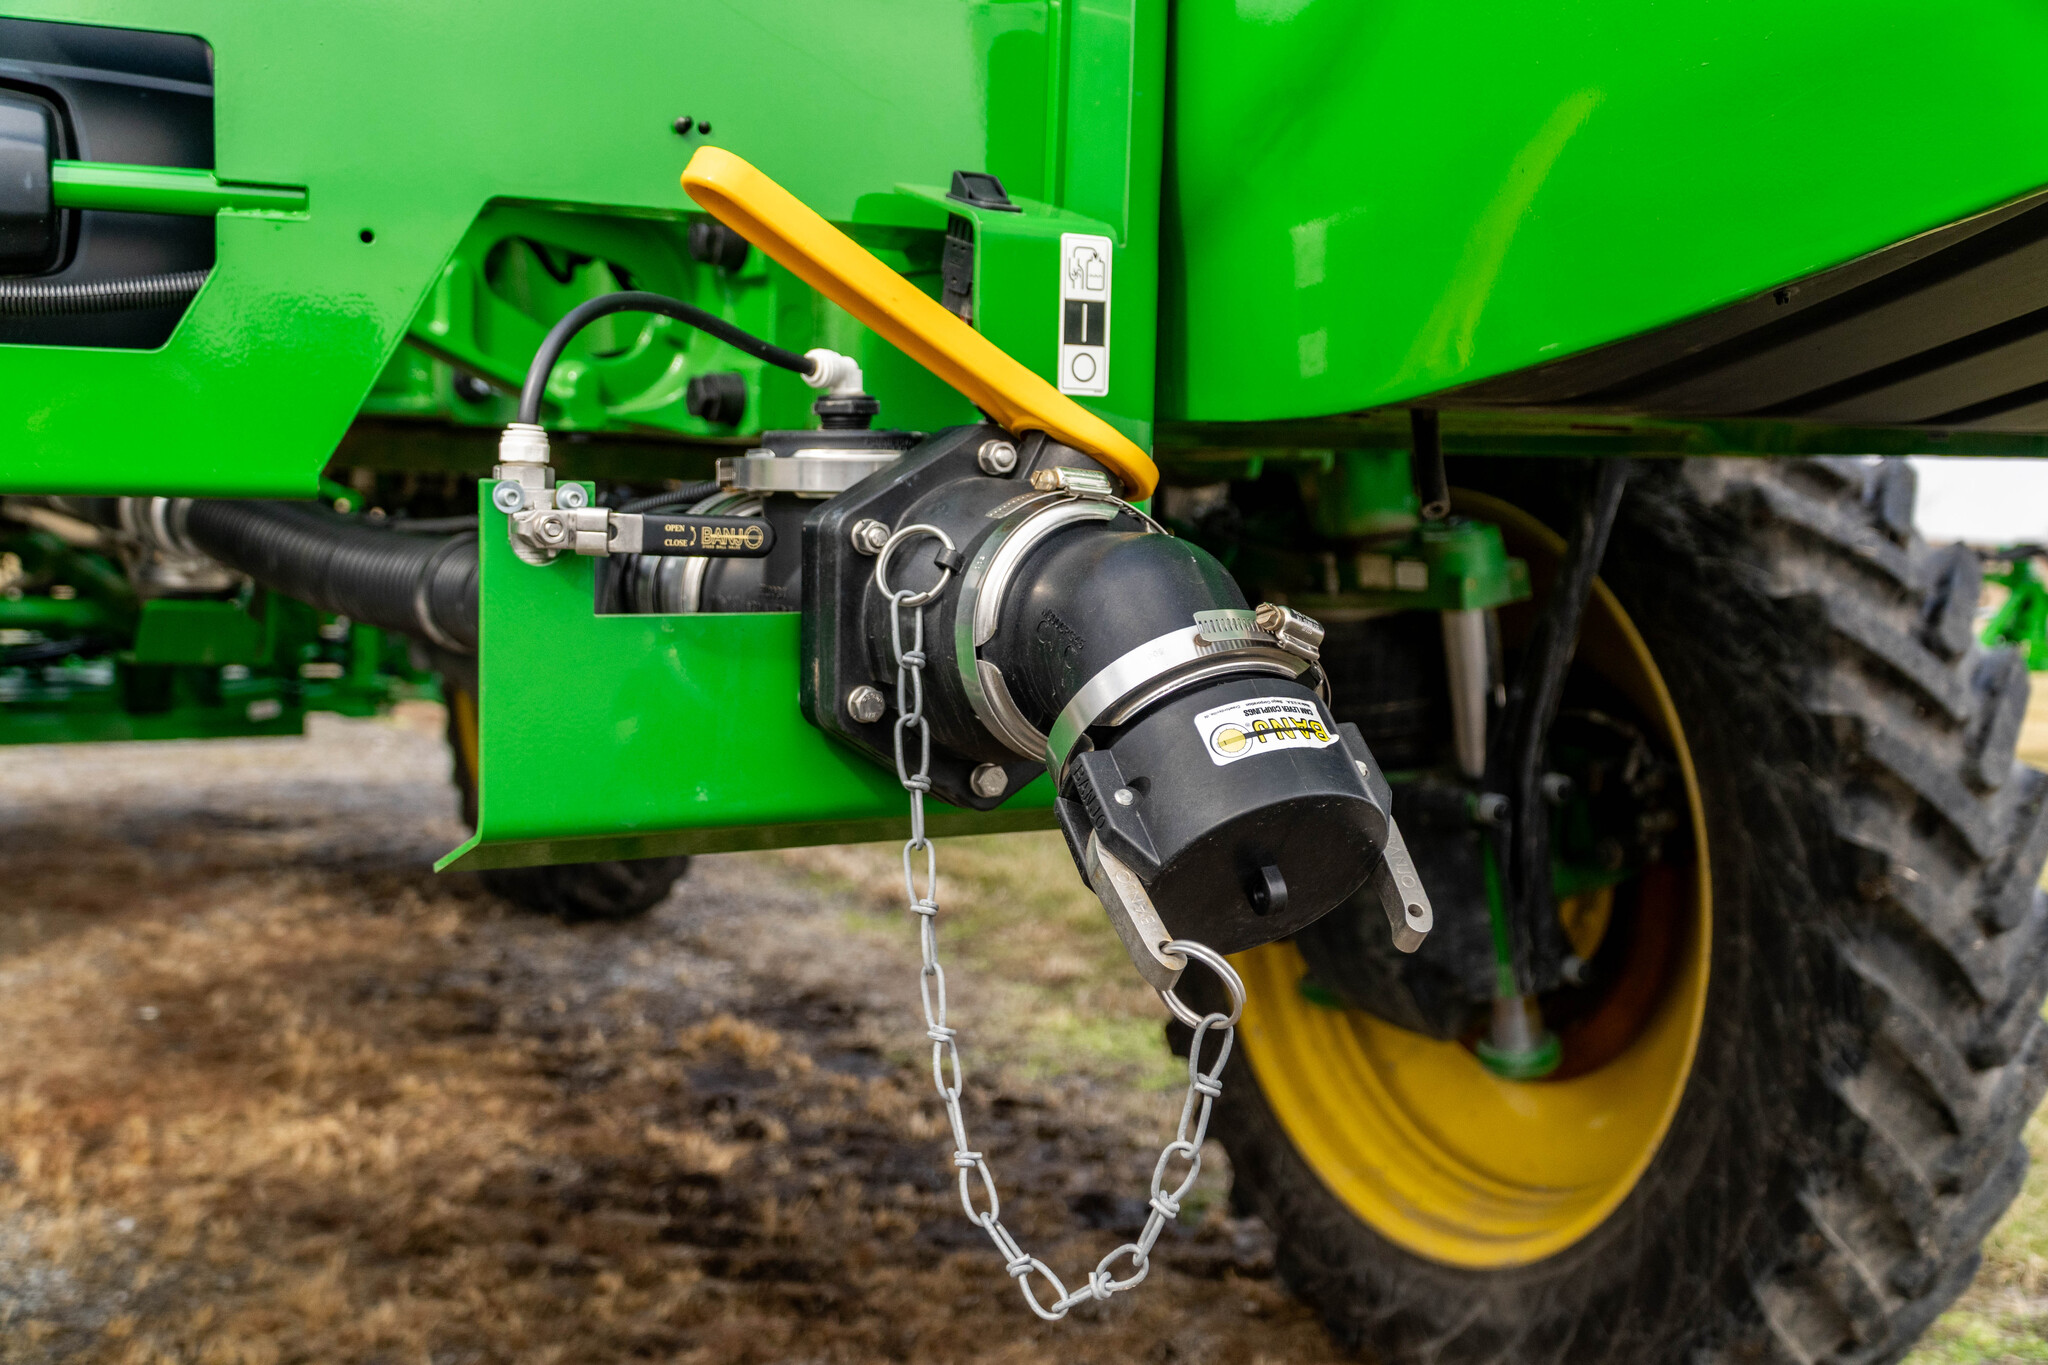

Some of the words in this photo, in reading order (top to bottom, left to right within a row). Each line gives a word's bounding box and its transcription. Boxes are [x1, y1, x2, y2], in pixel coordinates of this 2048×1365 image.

[664, 524, 685, 532] OPEN
[701, 525, 764, 550] BANJO
[664, 539, 688, 547] CLOSE
[1243, 705, 1282, 717] COUPLINGS
[1281, 705, 1301, 714] LEVER
[1300, 707, 1314, 716] CAM
[1073, 763, 1106, 829] BANJO
